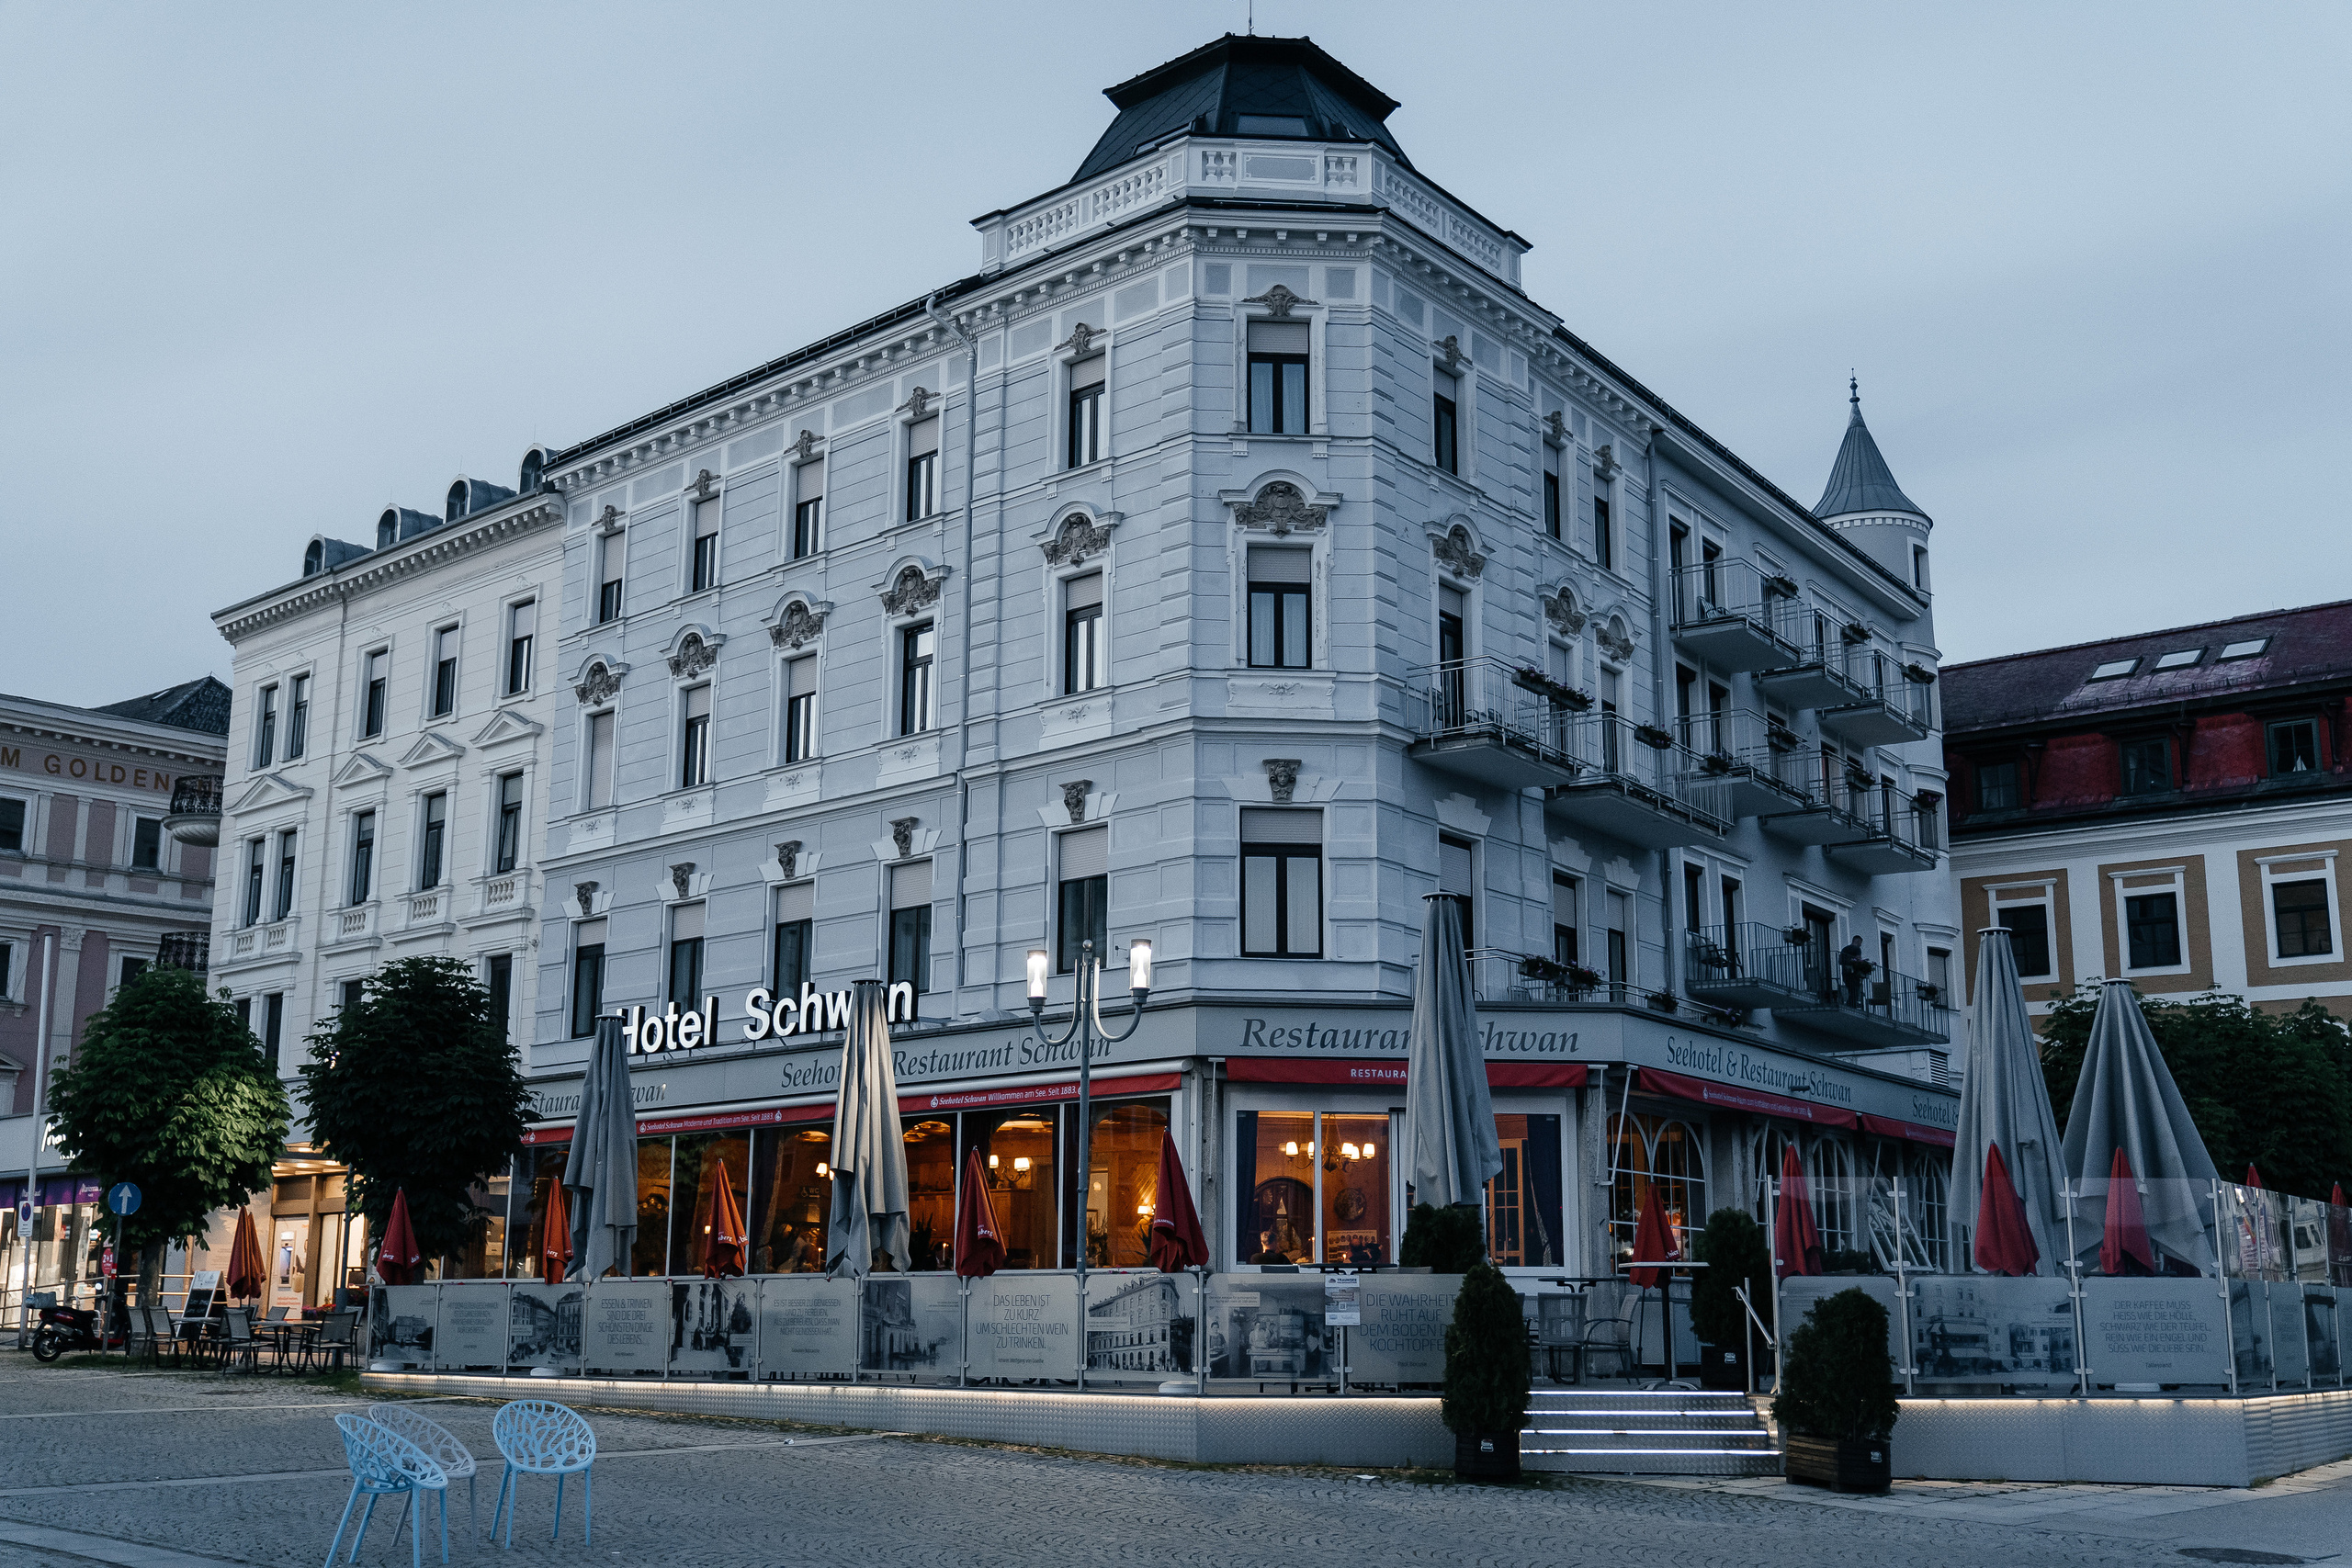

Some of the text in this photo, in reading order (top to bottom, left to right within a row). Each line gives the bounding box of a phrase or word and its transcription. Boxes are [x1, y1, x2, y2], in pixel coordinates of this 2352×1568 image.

[43, 753, 171, 792] GOLDEN
[616, 981, 919, 1055] Hotel Schwn
[781, 1058, 842, 1089] Seeho
[893, 1042, 1013, 1077] Restaurant
[1667, 1036, 1852, 1104] Seehotel & Restaurant Schwan
[1351, 1068, 1408, 1078] RESTAURA
[939, 1085, 1077, 1105] Seehotel Schwan Willkommen am See. Seit 1883.
[1912, 1094, 1951, 1124] Seehotel
[703, 1118, 713, 1126] und
[712, 1116, 733, 1125] Tradition
[751, 1113, 760, 1122] Seit
[601, 1298, 652, 1309] ESSEN & TRINKEN
[787, 1298, 806, 1307] BESSER
[993, 1294, 1050, 1307] DAS LEBEN IST
[1366, 1293, 1457, 1307] DIE WAHRHEIT
[2114, 1300, 2191, 1310] DER KAFFEE MUSS
[606, 1310, 646, 1321] SIND DIE DREI
[1003, 1308, 1040, 1321] ZU KURZ
[1381, 1308, 1442, 1322] RUHT AUF
[2113, 1311, 2137, 1321] HEISS
[2137, 1311, 2152, 1321] WIE
[2154, 1311, 2168, 1321] DIE
[634, 1322, 654, 1333] DINGE
[975, 1322, 1069, 1336] UM SCHLECHTEN WEIN
[1360, 1323, 1389, 1337] DEM
[1392, 1323, 1436, 1337] BODEN
[2099, 1322, 2211, 1332] SCHWARZ WIE DER TEUFEL,
[607, 1333, 619, 1345] DES
[995, 1336, 1046, 1349] ZU TRINKEN.
[1370, 1337, 1446, 1351] KOCHTOPFE
[2105, 1333, 2208, 1342] REIN WIE EIN ENGEL UND
[2108, 1343, 2130, 1353] SÜSS
[2131, 1344, 2146, 1353] WIE
[2148, 1344, 2163, 1353] DIE
